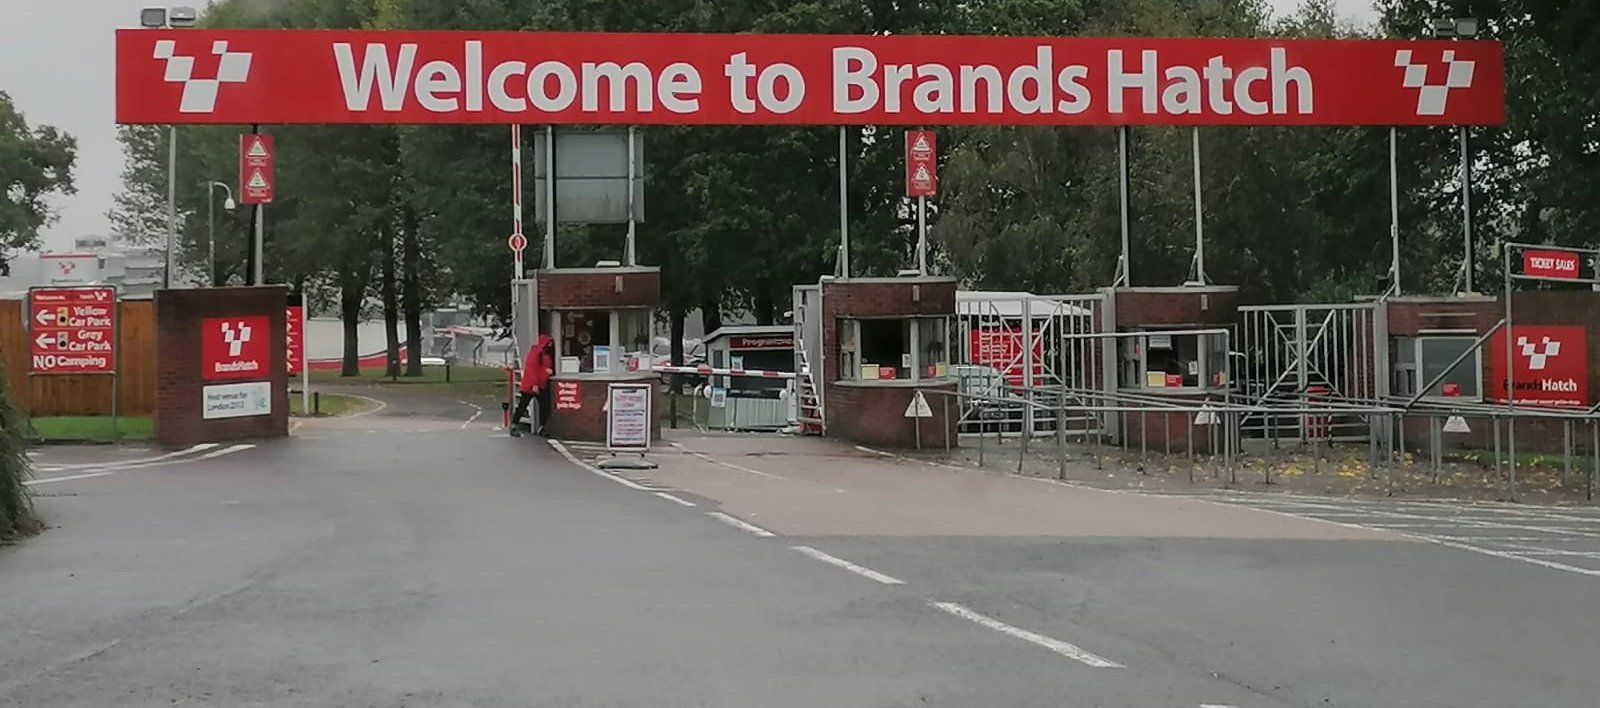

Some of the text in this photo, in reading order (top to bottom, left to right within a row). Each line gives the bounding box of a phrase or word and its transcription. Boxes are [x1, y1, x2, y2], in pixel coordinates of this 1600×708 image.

[333, 40, 1314, 116] Welcome to Brands Hatch
[73, 305, 108, 316] Yellow
[69, 317, 111, 326] Car Park
[77, 329, 103, 340] Grey
[69, 340, 111, 351] Car Park
[33, 355, 106, 369] NO Camping
